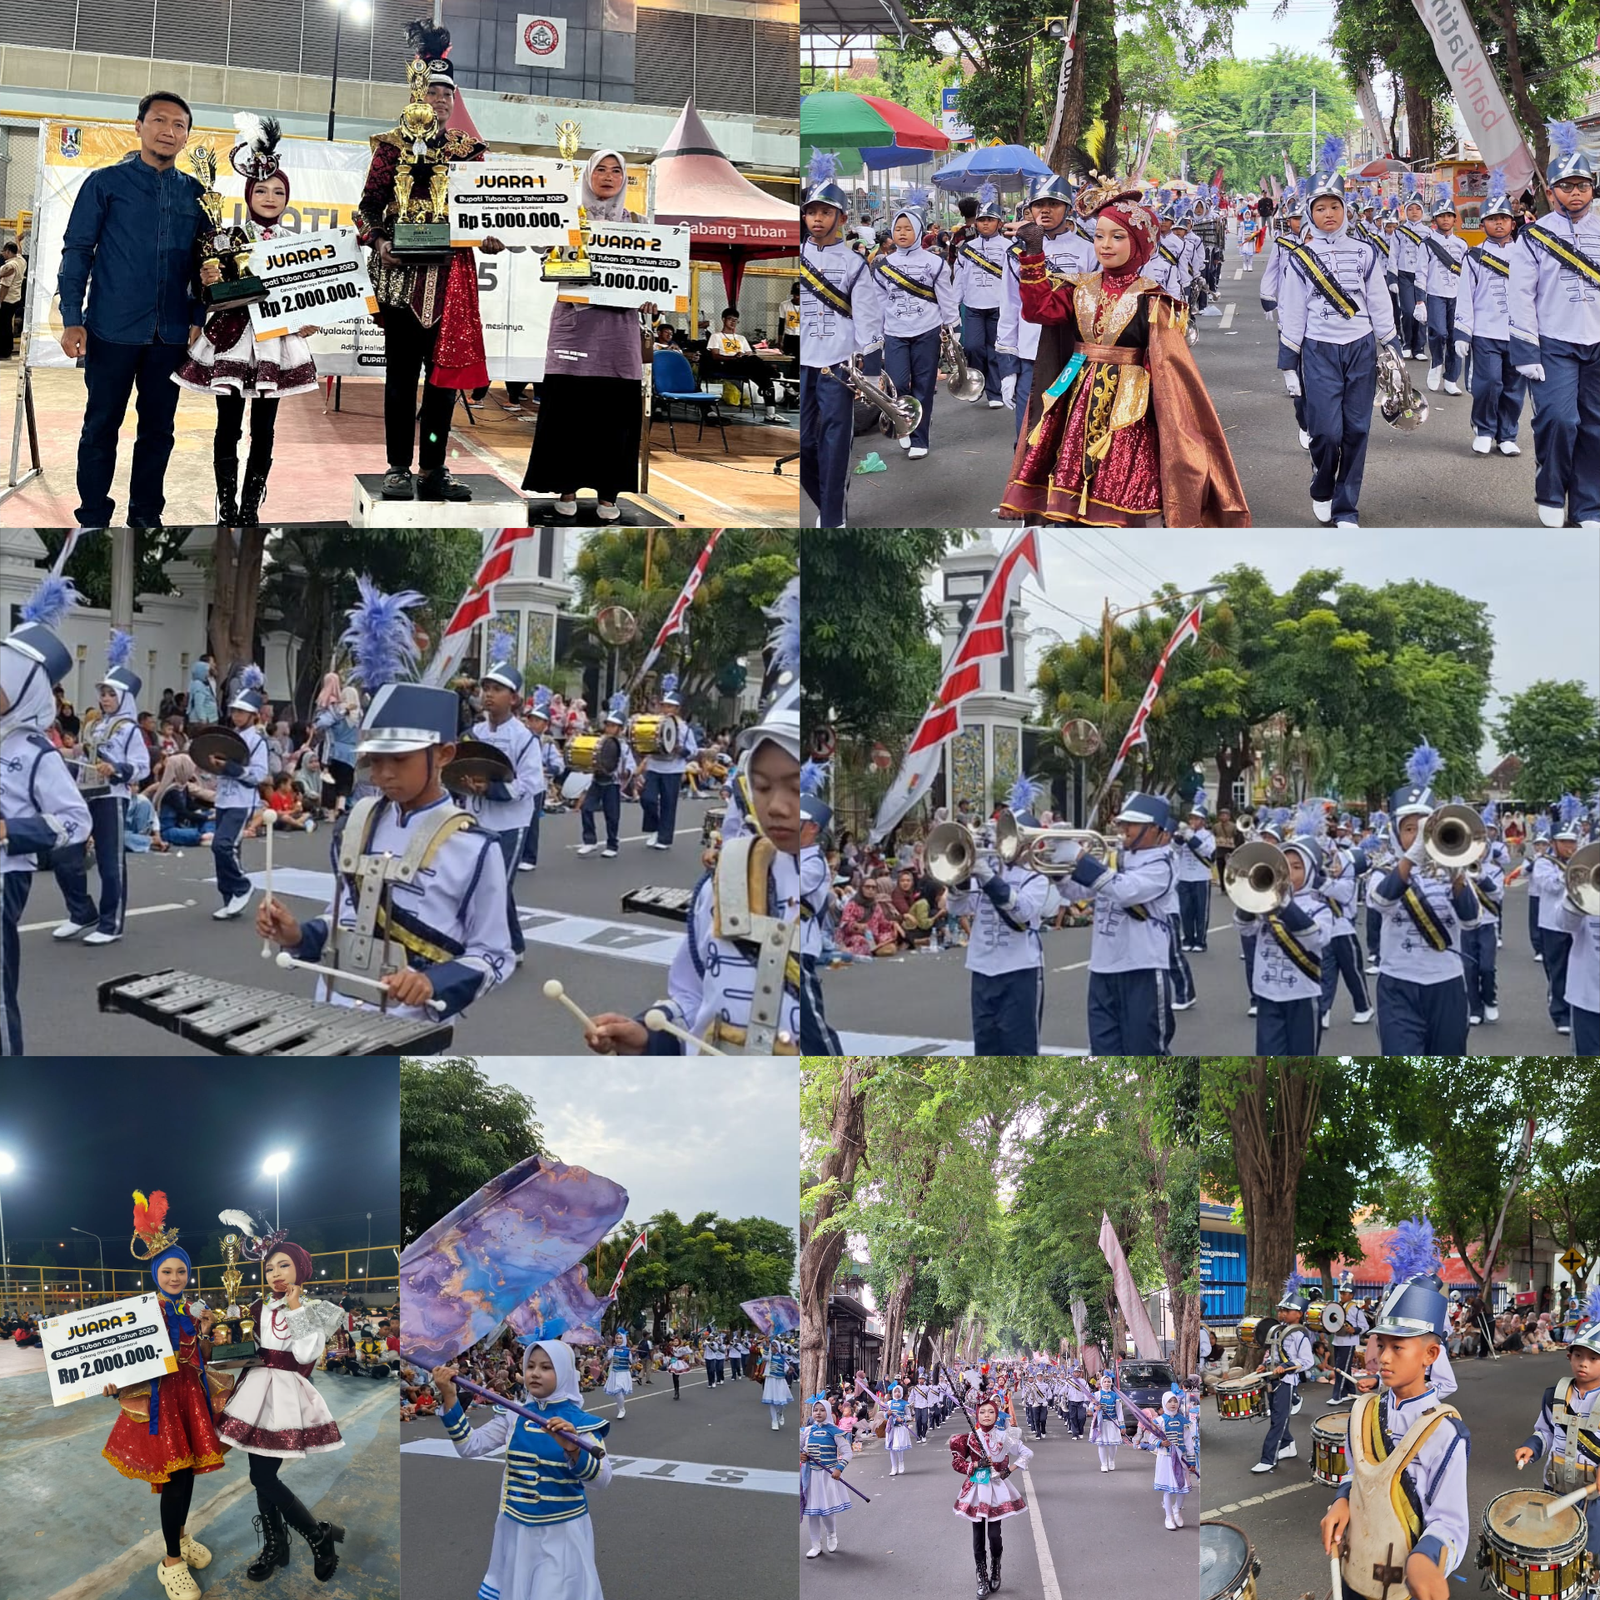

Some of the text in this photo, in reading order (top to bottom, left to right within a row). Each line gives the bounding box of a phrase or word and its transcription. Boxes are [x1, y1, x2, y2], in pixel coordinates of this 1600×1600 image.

[475, 175, 545, 188] JUARA 1
[508, 195, 521, 203] Cup
[458, 212, 570, 230] Rp 5.000.000,-
[741, 224, 787, 238] Tuban
[589, 233, 662, 252] JUARA 2
[266, 244, 336, 270] JUARA 3
[597, 254, 620, 263] Tuban
[620, 256, 634, 264] Cup
[636, 257, 657, 266] Tahun
[280, 274, 302, 284] Tuban
[303, 271, 317, 280] Cup
[317, 267, 338, 277] Tahun
[338, 262, 356, 272] 2025
[258, 281, 364, 319] Rp 2.000.000,-
[341, 344, 363, 352] Aditya
[67, 1315, 123, 1340] JUARA
[124, 1311, 137, 1325] 3
[55, 1326, 156, 1358] Bupati Tuban Cup Tahun 2025
[57, 1344, 163, 1385] Rp 2.000.000,-
